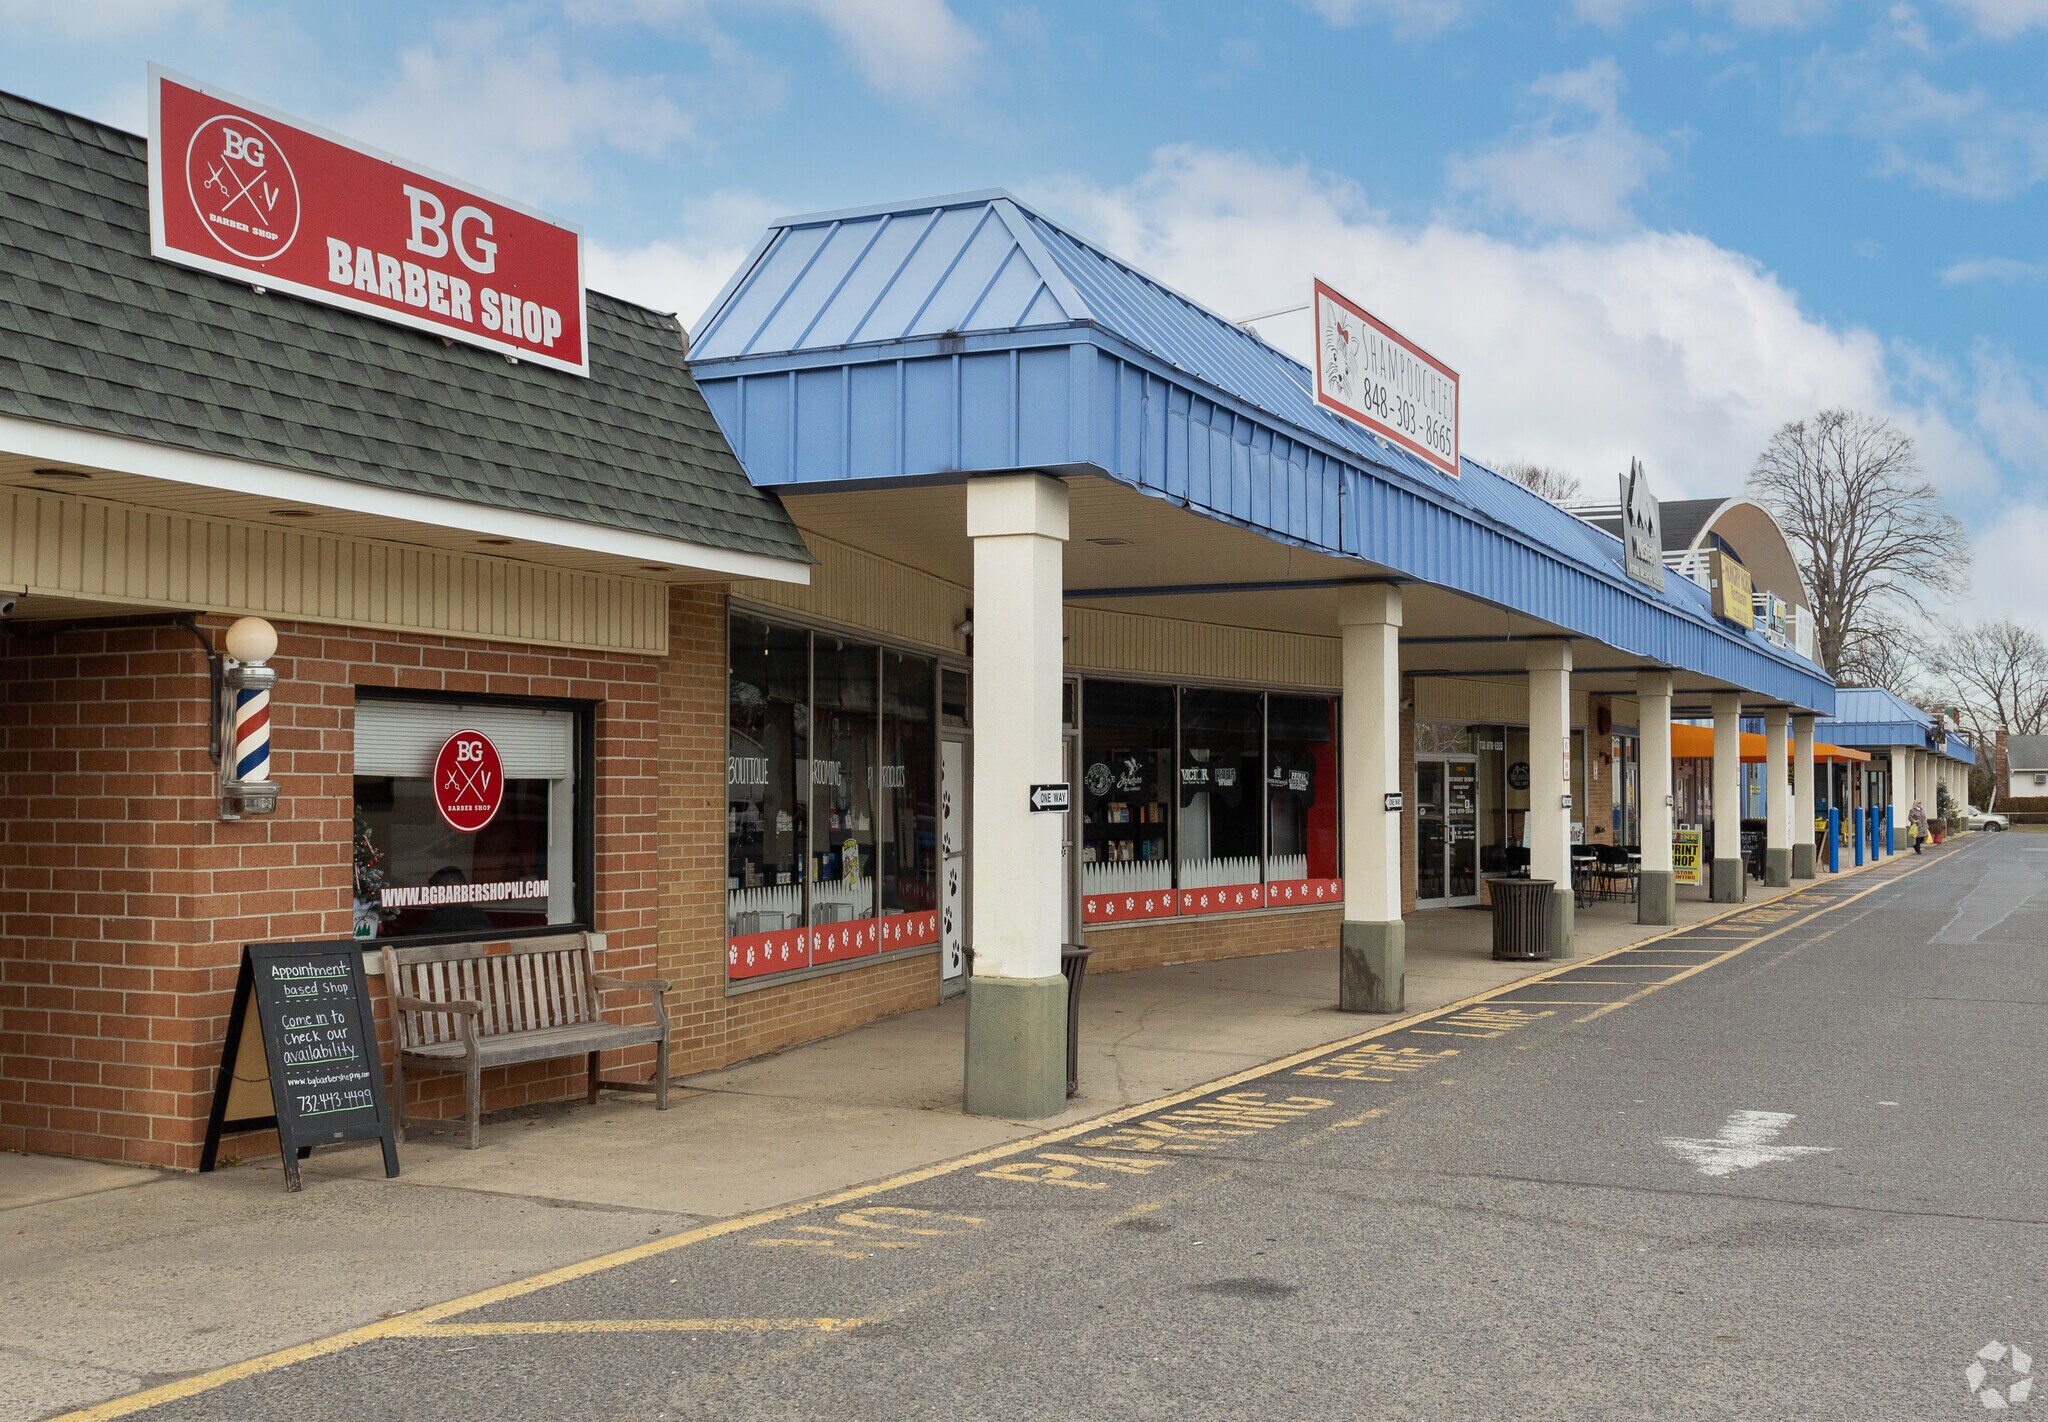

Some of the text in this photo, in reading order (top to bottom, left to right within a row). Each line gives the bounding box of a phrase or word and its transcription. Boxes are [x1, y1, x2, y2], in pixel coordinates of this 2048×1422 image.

[223, 127, 265, 167] BG
[209, 213, 278, 241] BARBER SHOP
[403, 184, 497, 274] BG
[327, 236, 562, 348] BARBER SHOP
[1362, 324, 1453, 422] SHAMPOOCHIES
[1363, 377, 1452, 457] 848-303-8665
[457, 741, 483, 762] BG
[728, 756, 769, 785] BOUTIQUE
[813, 759, 842, 787] ROOMING
[1181, 768, 1209, 780] VICTOR
[1041, 793, 1066, 803] ONE WAY
[1673, 855, 1695, 867] HOP
[381, 880, 549, 908] WWW.BGBARBERSHOPNJ.COM
[284, 982, 348, 996] based Shop
[282, 1010, 345, 1028] Come in to
[327, 1028, 348, 1041] our
[284, 1042, 355, 1063] availability
[1291, 1044, 1459, 1082] FIRE
[974, 1091, 1334, 1190] PARKING
[747, 1206, 986, 1260] NO
